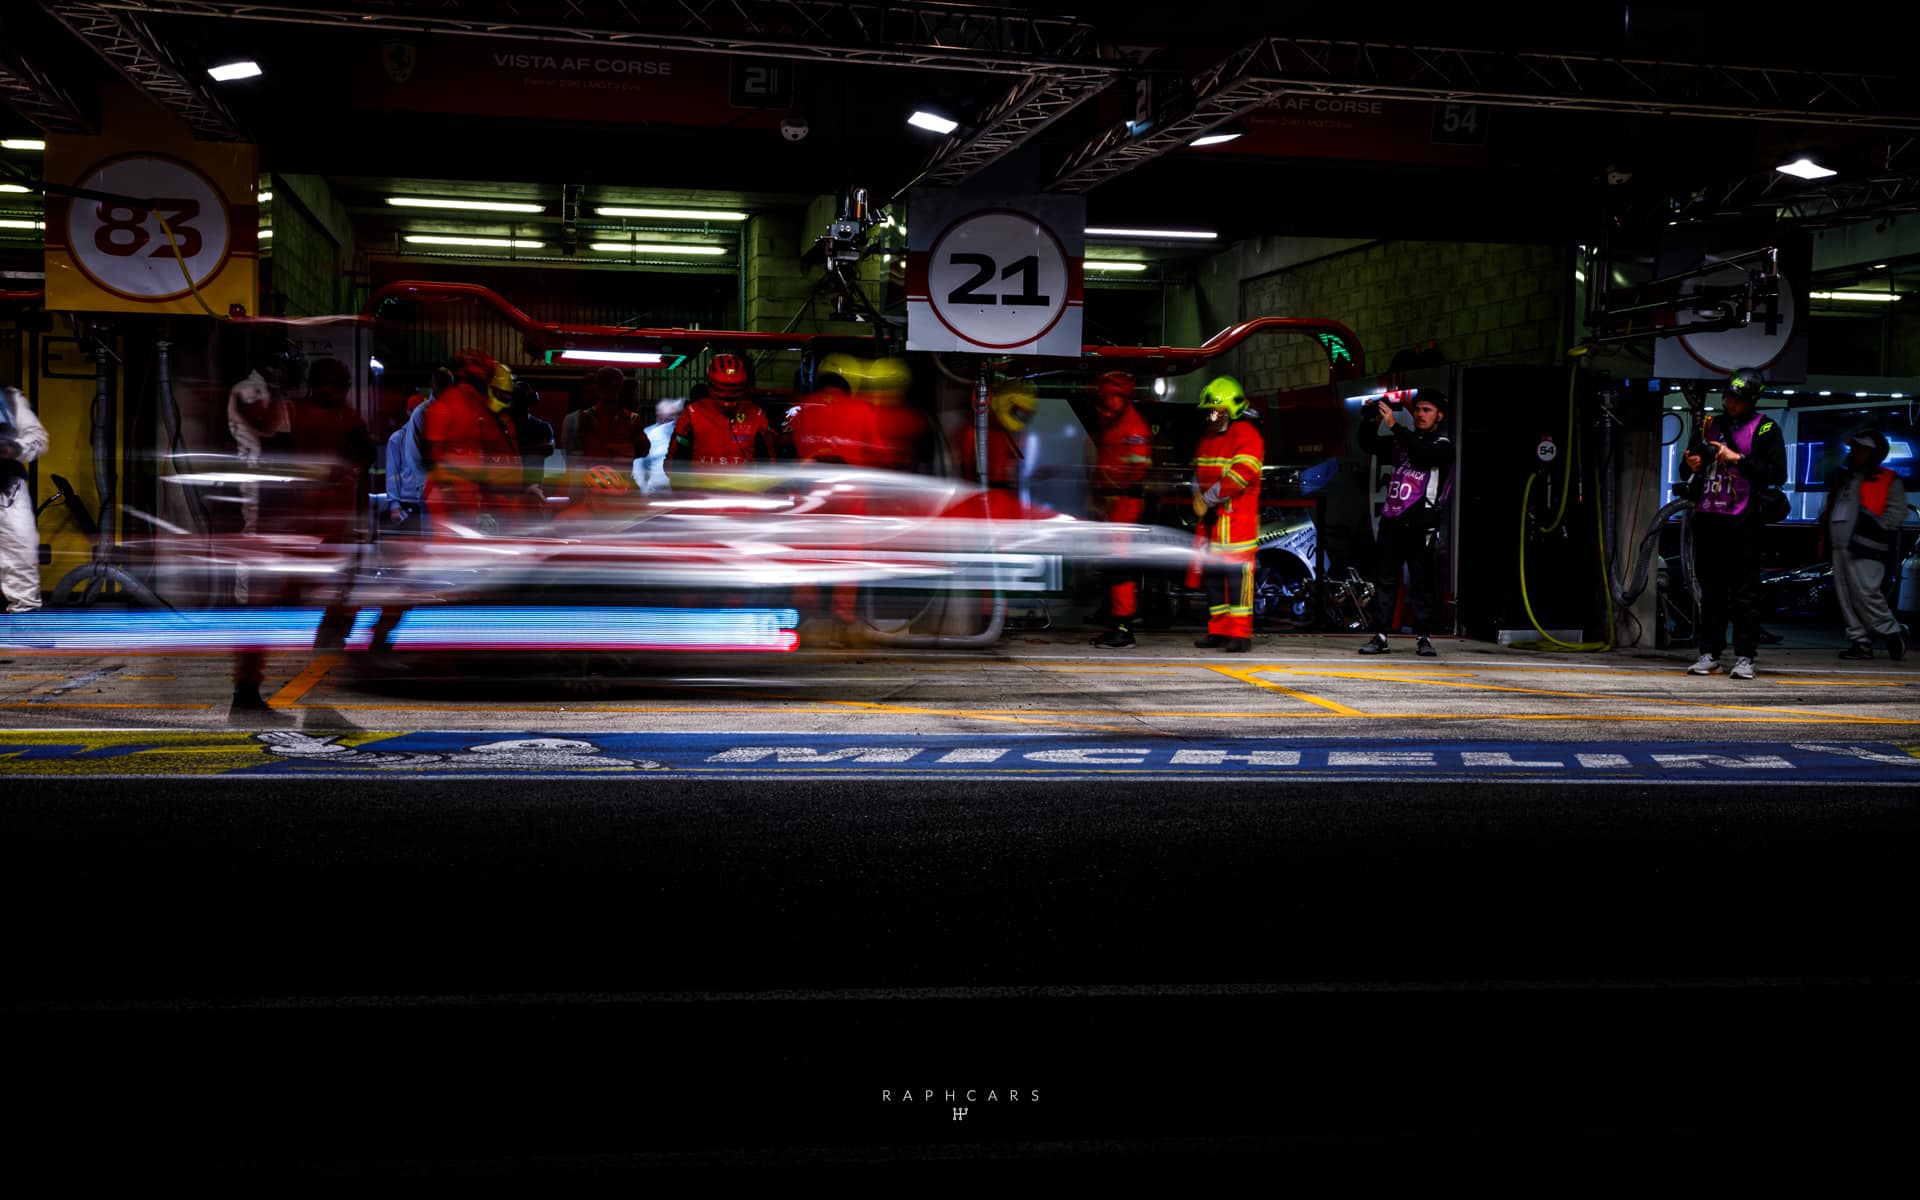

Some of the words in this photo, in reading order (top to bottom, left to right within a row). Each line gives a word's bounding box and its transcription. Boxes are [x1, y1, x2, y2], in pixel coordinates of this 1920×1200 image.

[493, 51, 557, 70] VISTA
[560, 57, 591, 71] AF
[594, 58, 672, 76] CORSE
[744, 67, 779, 95] 21
[1285, 97, 1311, 110] AF
[1314, 98, 1383, 114] CORSE
[1441, 104, 1479, 134] 54
[95, 199, 202, 258] 83
[948, 253, 1050, 306] 21
[1540, 446, 1554, 455] 54
[704, 747, 1797, 769] MICHELIN
